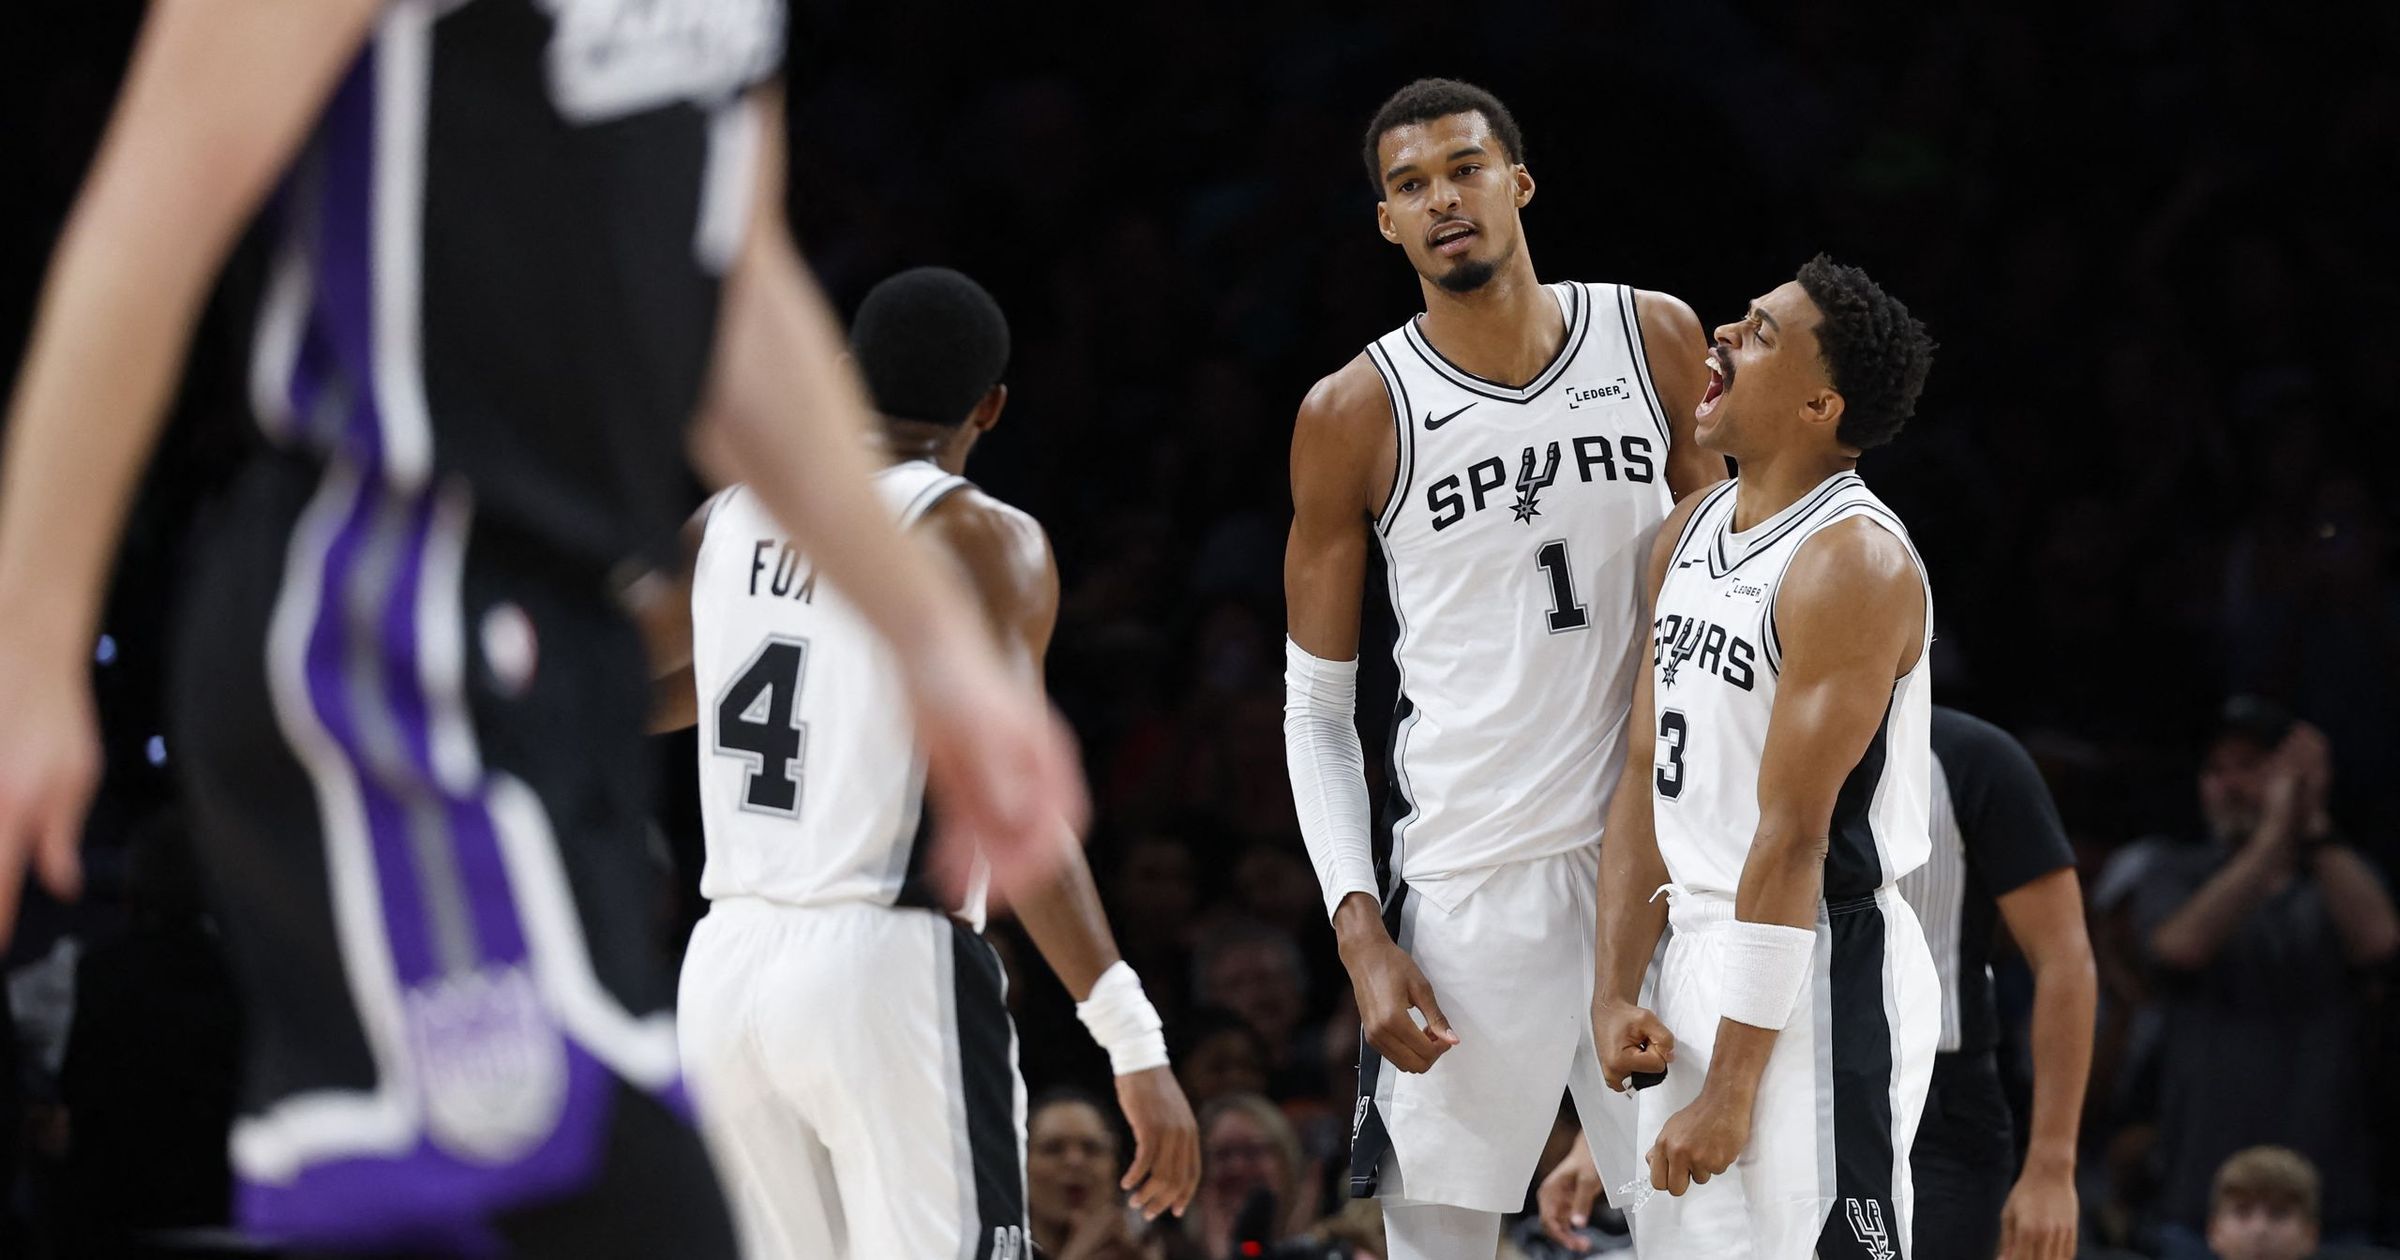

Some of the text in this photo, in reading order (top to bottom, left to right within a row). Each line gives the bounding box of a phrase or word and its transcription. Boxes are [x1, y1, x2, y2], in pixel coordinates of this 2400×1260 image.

[1575, 385, 1621, 402] LEDGER
[1427, 435, 1654, 532] SPURS
[1535, 538, 1590, 634] 1
[713, 632, 810, 820] 4
[1655, 706, 1689, 803] 3
